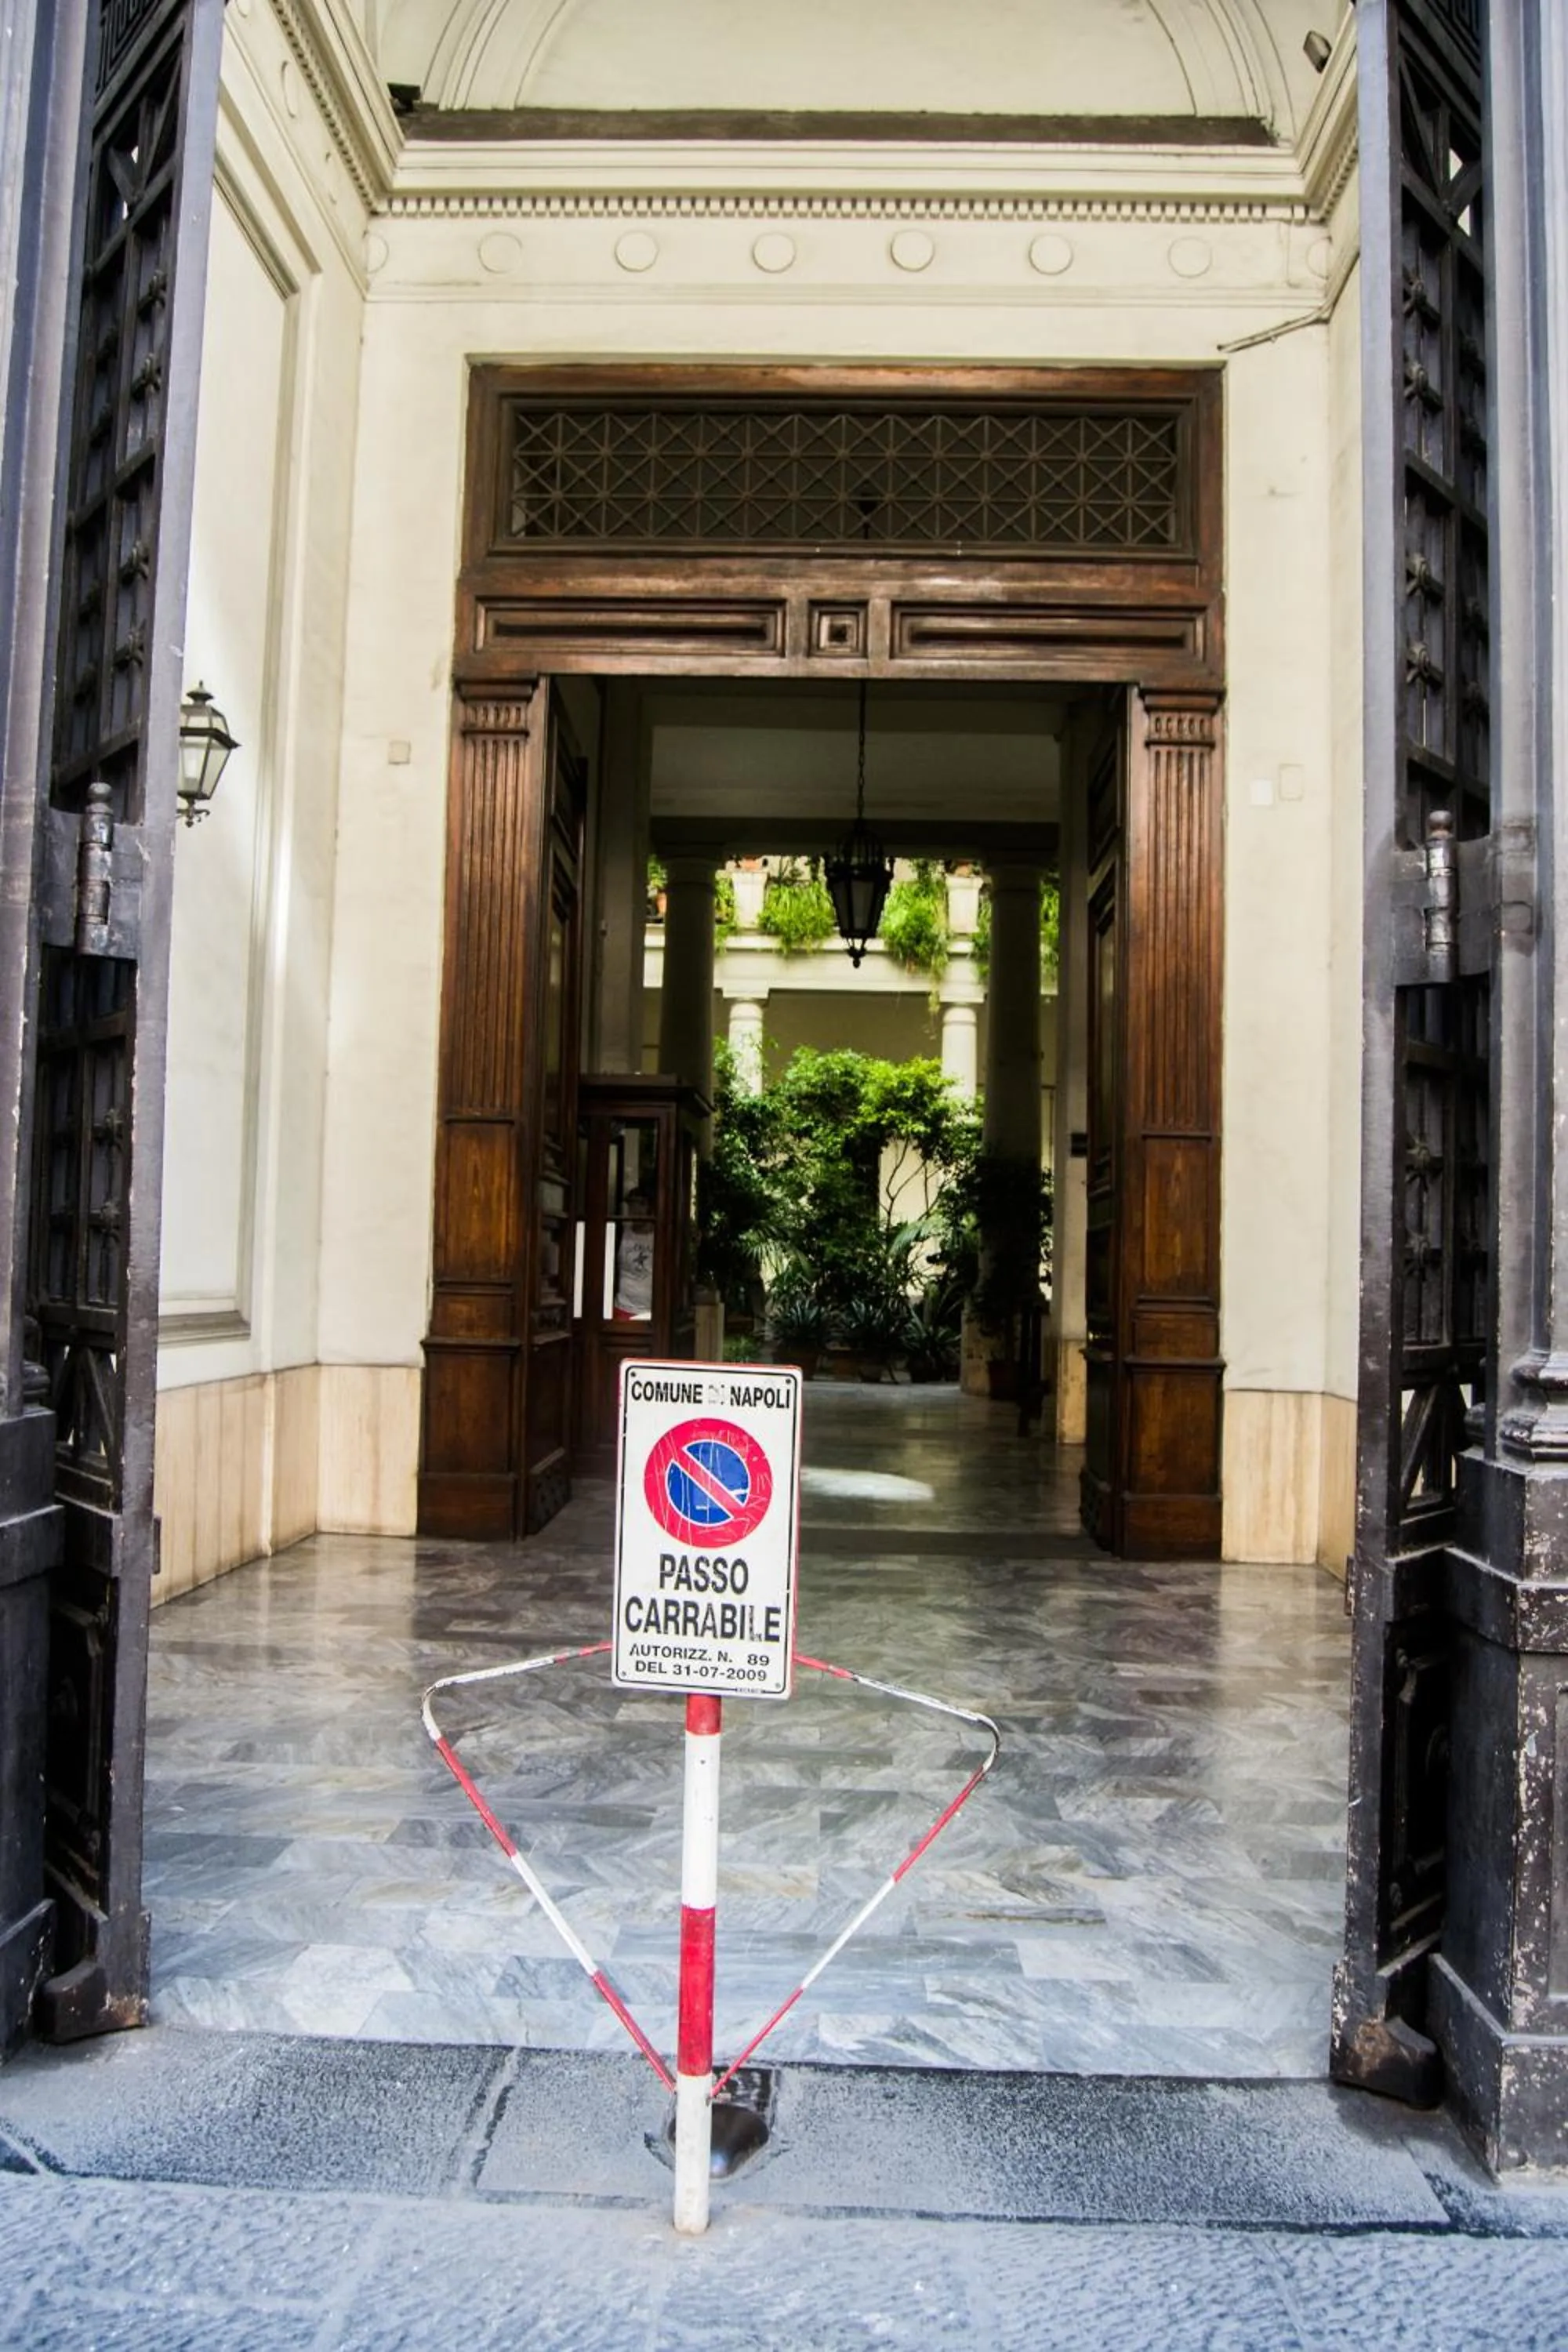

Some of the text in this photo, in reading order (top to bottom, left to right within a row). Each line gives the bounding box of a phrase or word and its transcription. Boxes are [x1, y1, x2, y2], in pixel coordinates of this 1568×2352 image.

[631, 1381, 703, 1403] COMUNE
[730, 1386, 790, 1409] NAPOLI
[659, 1553, 749, 1595] PASSO
[625, 1595, 781, 1642] CARRABILE
[630, 1643, 769, 1666] AUTORIZZ. N. 89
[635, 1660, 767, 1681] DEL 31-07-2009
